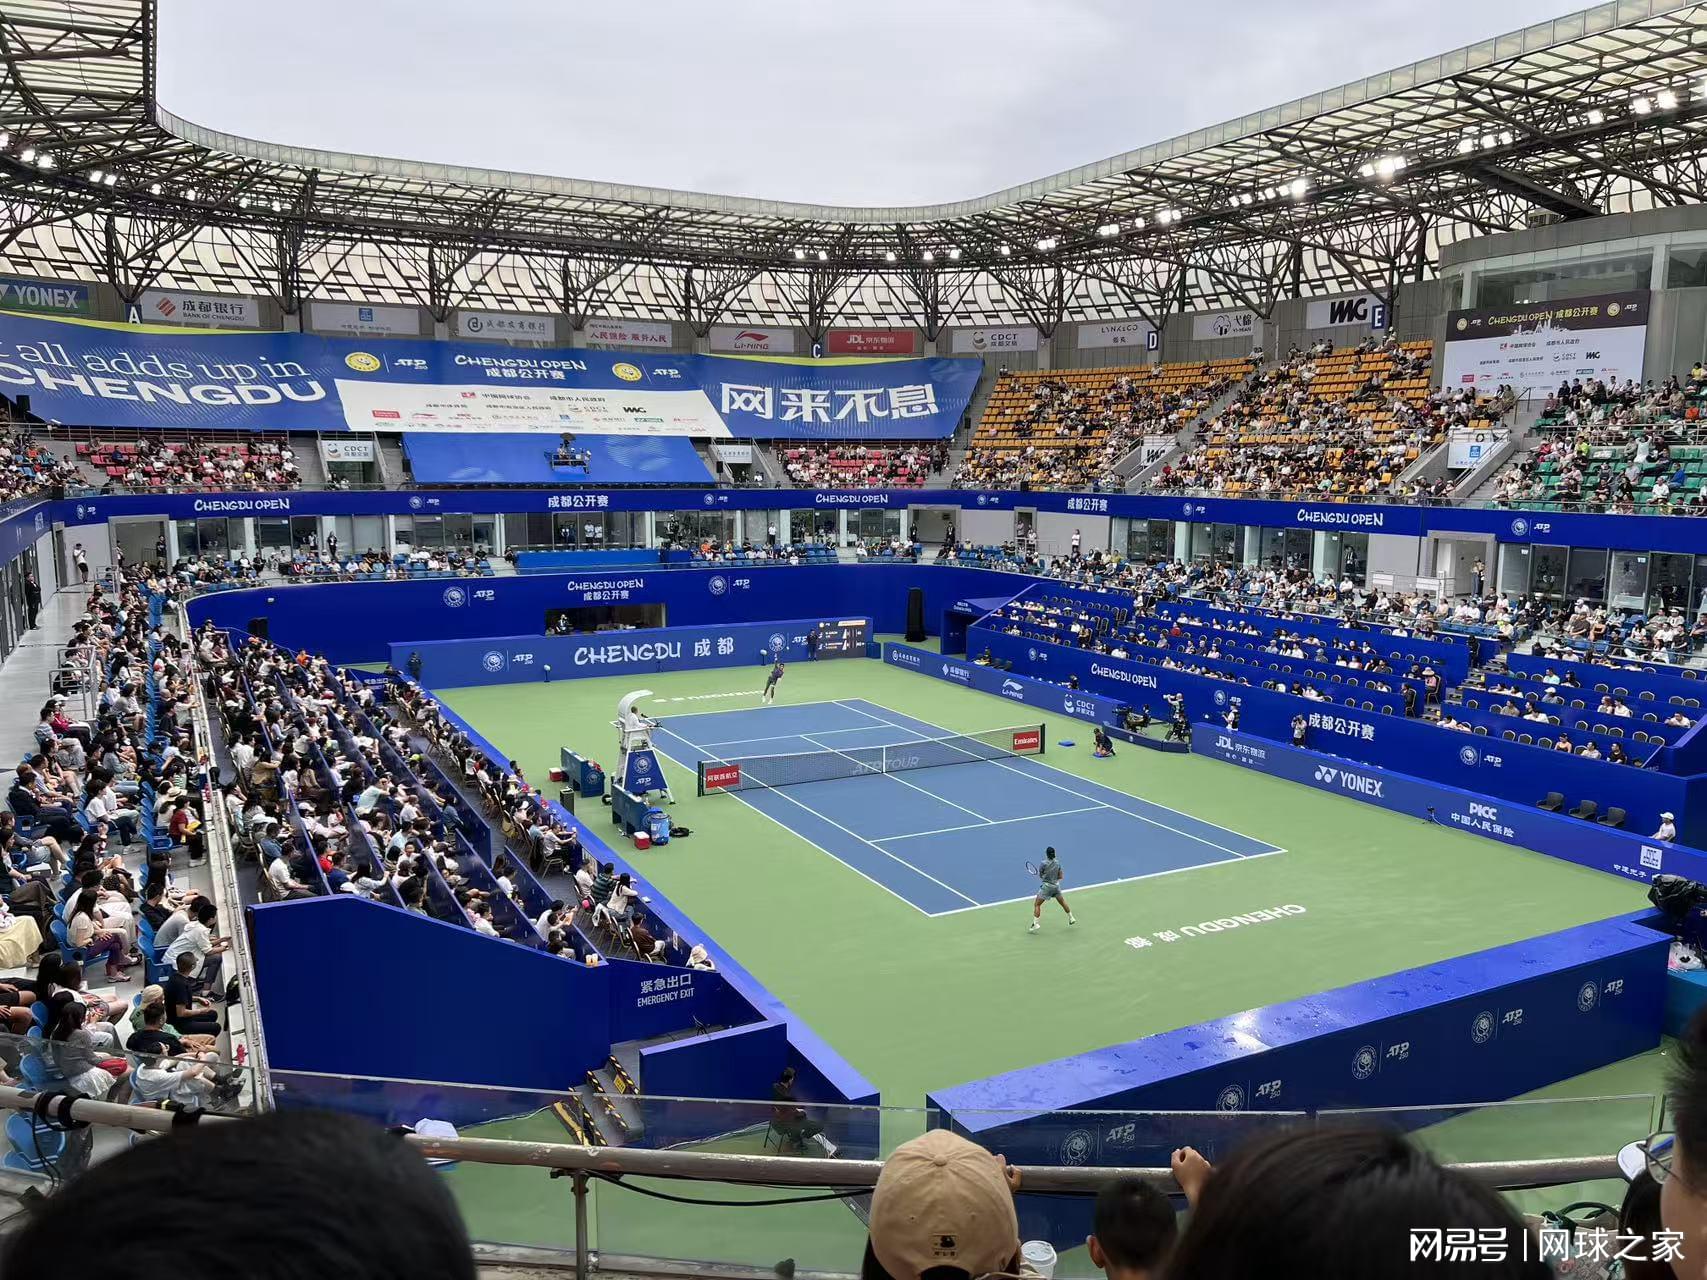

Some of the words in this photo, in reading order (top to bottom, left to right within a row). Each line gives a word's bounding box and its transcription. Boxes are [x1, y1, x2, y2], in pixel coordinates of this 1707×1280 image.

[14, 285, 79, 309] YONEX
[128, 306, 140, 325] A
[182, 300, 244, 315] 成都银行
[1488, 315, 1528, 326] CHENGDU
[1529, 311, 1554, 321] OPEN
[1555, 306, 1600, 319] 成都公开赛
[1374, 308, 1383, 328] E
[846, 334, 864, 344] JDL
[1148, 333, 1158, 349] D
[812, 344, 821, 358] C
[16, 341, 79, 368] all
[82, 352, 194, 380] adds
[196, 364, 257, 384] up
[258, 356, 311, 379] in
[454, 354, 539, 369] CHENGDU
[541, 359, 587, 371] OPEN
[486, 368, 566, 380] 成都公开赛
[0, 361, 327, 405] CHENGDU
[720, 382, 939, 423] 网来不息
[194, 499, 254, 511] CHENGDU
[255, 498, 290, 510] OPEN
[548, 495, 609, 508] 成都公开赛
[815, 494, 861, 503] CHENGDU
[862, 494, 888, 503] OPEN
[1067, 499, 1108, 512] 成都公开赛
[1297, 509, 1350, 524] CHENGDU
[1351, 512, 1384, 527] OPEN
[567, 581, 616, 591] CHENGDU
[616, 578, 644, 589] OPEN
[473, 590, 495, 599] ATP
[583, 590, 629, 601] 成都公开赛
[512, 654, 533, 662] ATP
[574, 642, 681, 665] CHENGDU
[694, 637, 734, 657] 成都
[1091, 663, 1131, 683] CHENGDU
[1132, 674, 1157, 689] OPEN
[1076, 700, 1095, 710] CDCT
[1308, 712, 1376, 741] 成都公开赛
[1014, 736, 1038, 746] Emirates
[1215, 735, 1234, 750] JDL
[1484, 754, 1502, 765] ATP
[1340, 770, 1383, 798] YONEX
[1469, 802, 1497, 821] PICC
[1451, 812, 1515, 838] 中国人民保险
[1180, 904, 1307, 937] CHENGDU
[640, 973, 692, 994] 紧急出口
[1604, 979, 1624, 994] ATP
[637, 991, 678, 1007] EMERGENCY
[680, 988, 695, 999] EXIT
[1502, 1008, 1523, 1024] ATP
[1386, 1041, 1410, 1059] ATP
[1256, 1079, 1282, 1098] ATP
[1106, 1123, 1136, 1143] ATP
